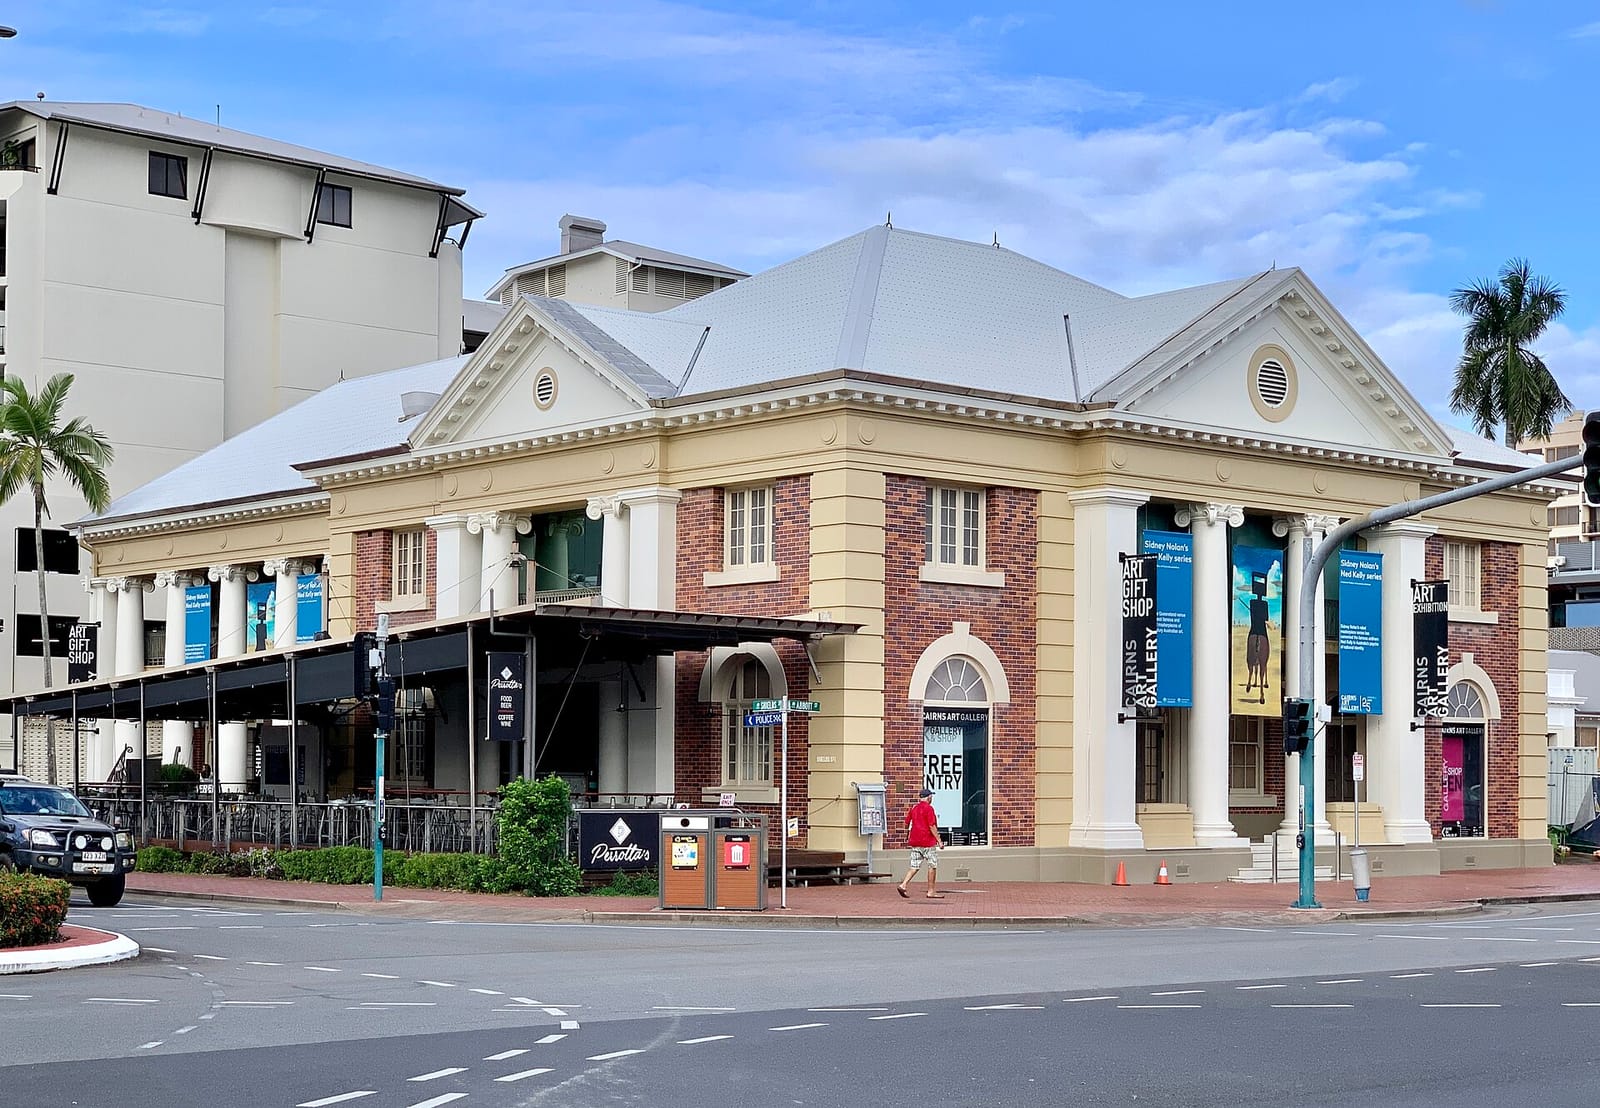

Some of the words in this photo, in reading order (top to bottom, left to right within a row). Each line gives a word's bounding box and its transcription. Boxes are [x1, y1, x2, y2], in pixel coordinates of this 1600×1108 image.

[1144, 540, 1164, 551] Sidney
[1166, 542, 1188, 552] Nolan's
[1158, 552, 1172, 562] Kelly
[1174, 554, 1192, 562] series
[1123, 559, 1144, 578] ART
[1340, 560, 1358, 569] Sidney
[1360, 561, 1379, 570] Nolan's
[1352, 572, 1366, 580] Kelly
[1123, 579, 1148, 598] GIFT
[1414, 585, 1435, 602] ART
[1123, 598, 1154, 618] SHOP
[1414, 602, 1448, 613] EXHIBITION
[69, 625, 87, 638] ART
[69, 639, 90, 651] GIFT
[69, 651, 94, 664] SHOP
[1126, 640, 1136, 707] CAIRNS
[1146, 627, 1158, 708] GALLERY
[1417, 656, 1428, 717] CAIRNS
[1437, 646, 1448, 717] GALLERY
[1136, 672, 1147, 707] ART
[796, 701, 813, 710] ABBOTT
[1427, 686, 1438, 717] ART
[923, 712, 946, 720] CAIRNS
[947, 712, 960, 721] ART
[960, 713, 988, 721] GALLERY
[930, 727, 961, 736] GALLERY
[1448, 767, 1462, 776] SHOP
[923, 774, 962, 790] NTRY
[591, 843, 650, 864] Perrotta's
